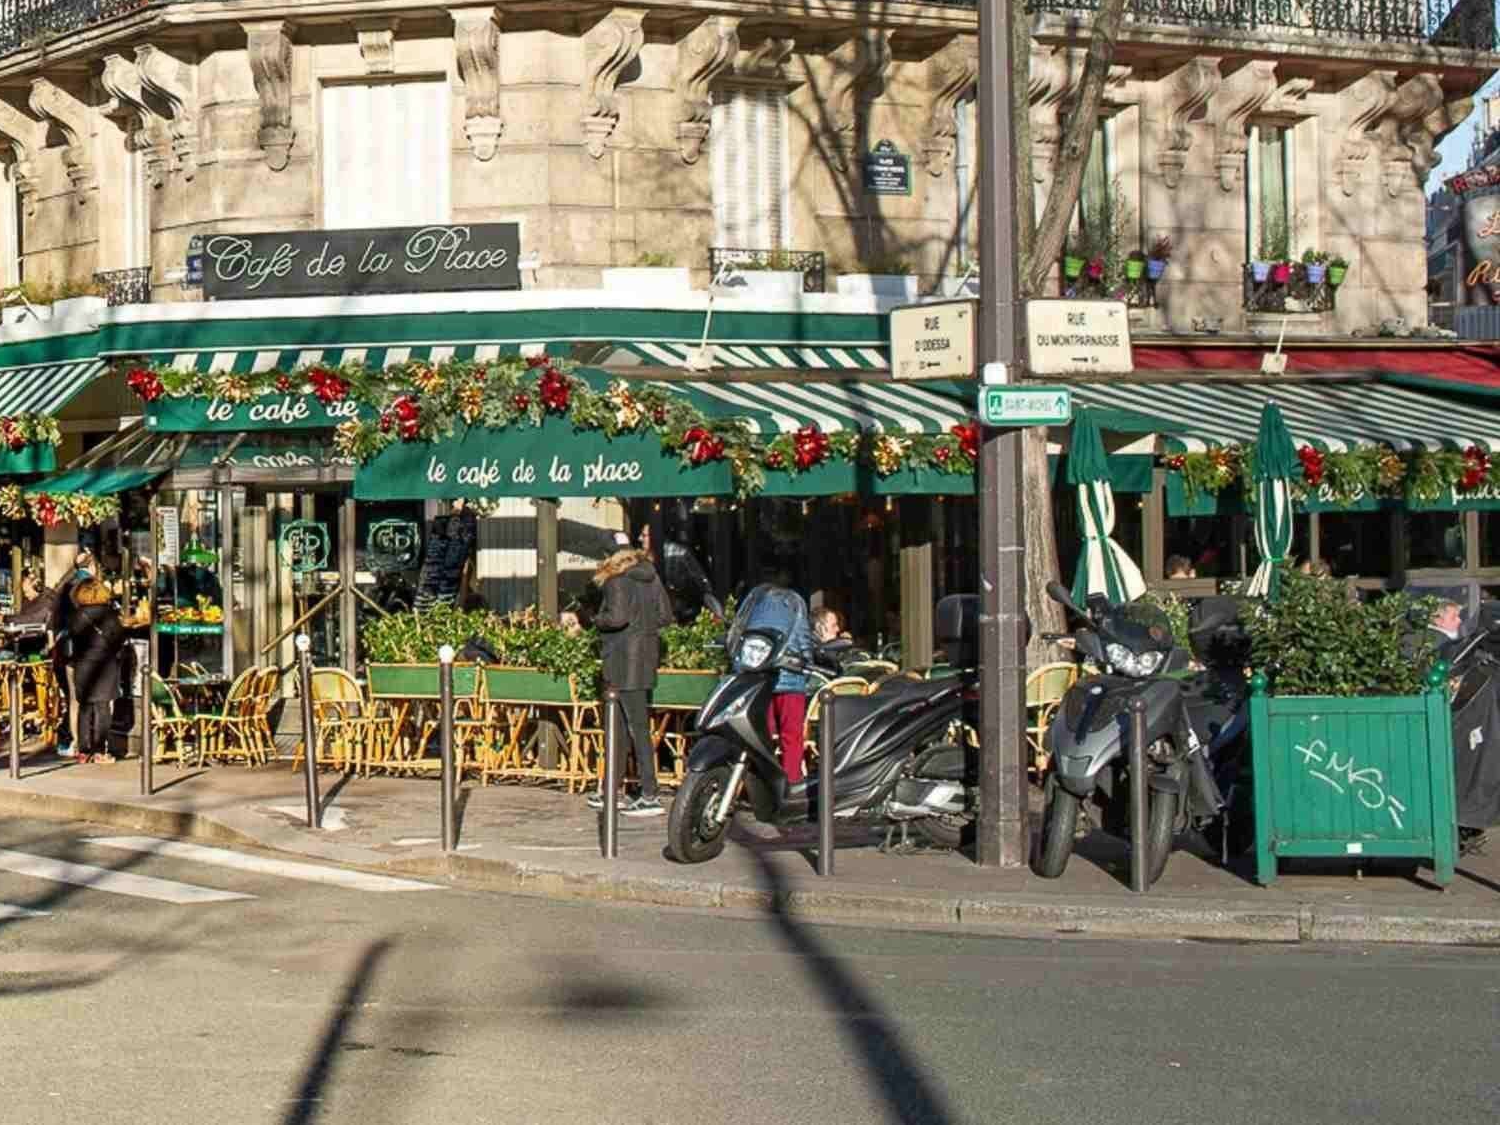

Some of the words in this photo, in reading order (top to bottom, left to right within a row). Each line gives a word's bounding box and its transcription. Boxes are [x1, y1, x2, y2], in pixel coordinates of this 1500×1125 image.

[205, 235, 299, 289] Café
[306, 240, 346, 277] de
[357, 239, 394, 274] la
[403, 225, 509, 273] Place
[924, 316, 941, 330] RUE
[1066, 312, 1086, 326] RUE
[1051, 334, 1120, 347] MONTPARNASSE
[206, 398, 234, 422] le
[250, 395, 311, 424] café
[426, 455, 448, 483] le
[456, 457, 501, 488] café
[511, 457, 537, 484] de
[547, 454, 573, 483] la
[583, 453, 643, 488] place
